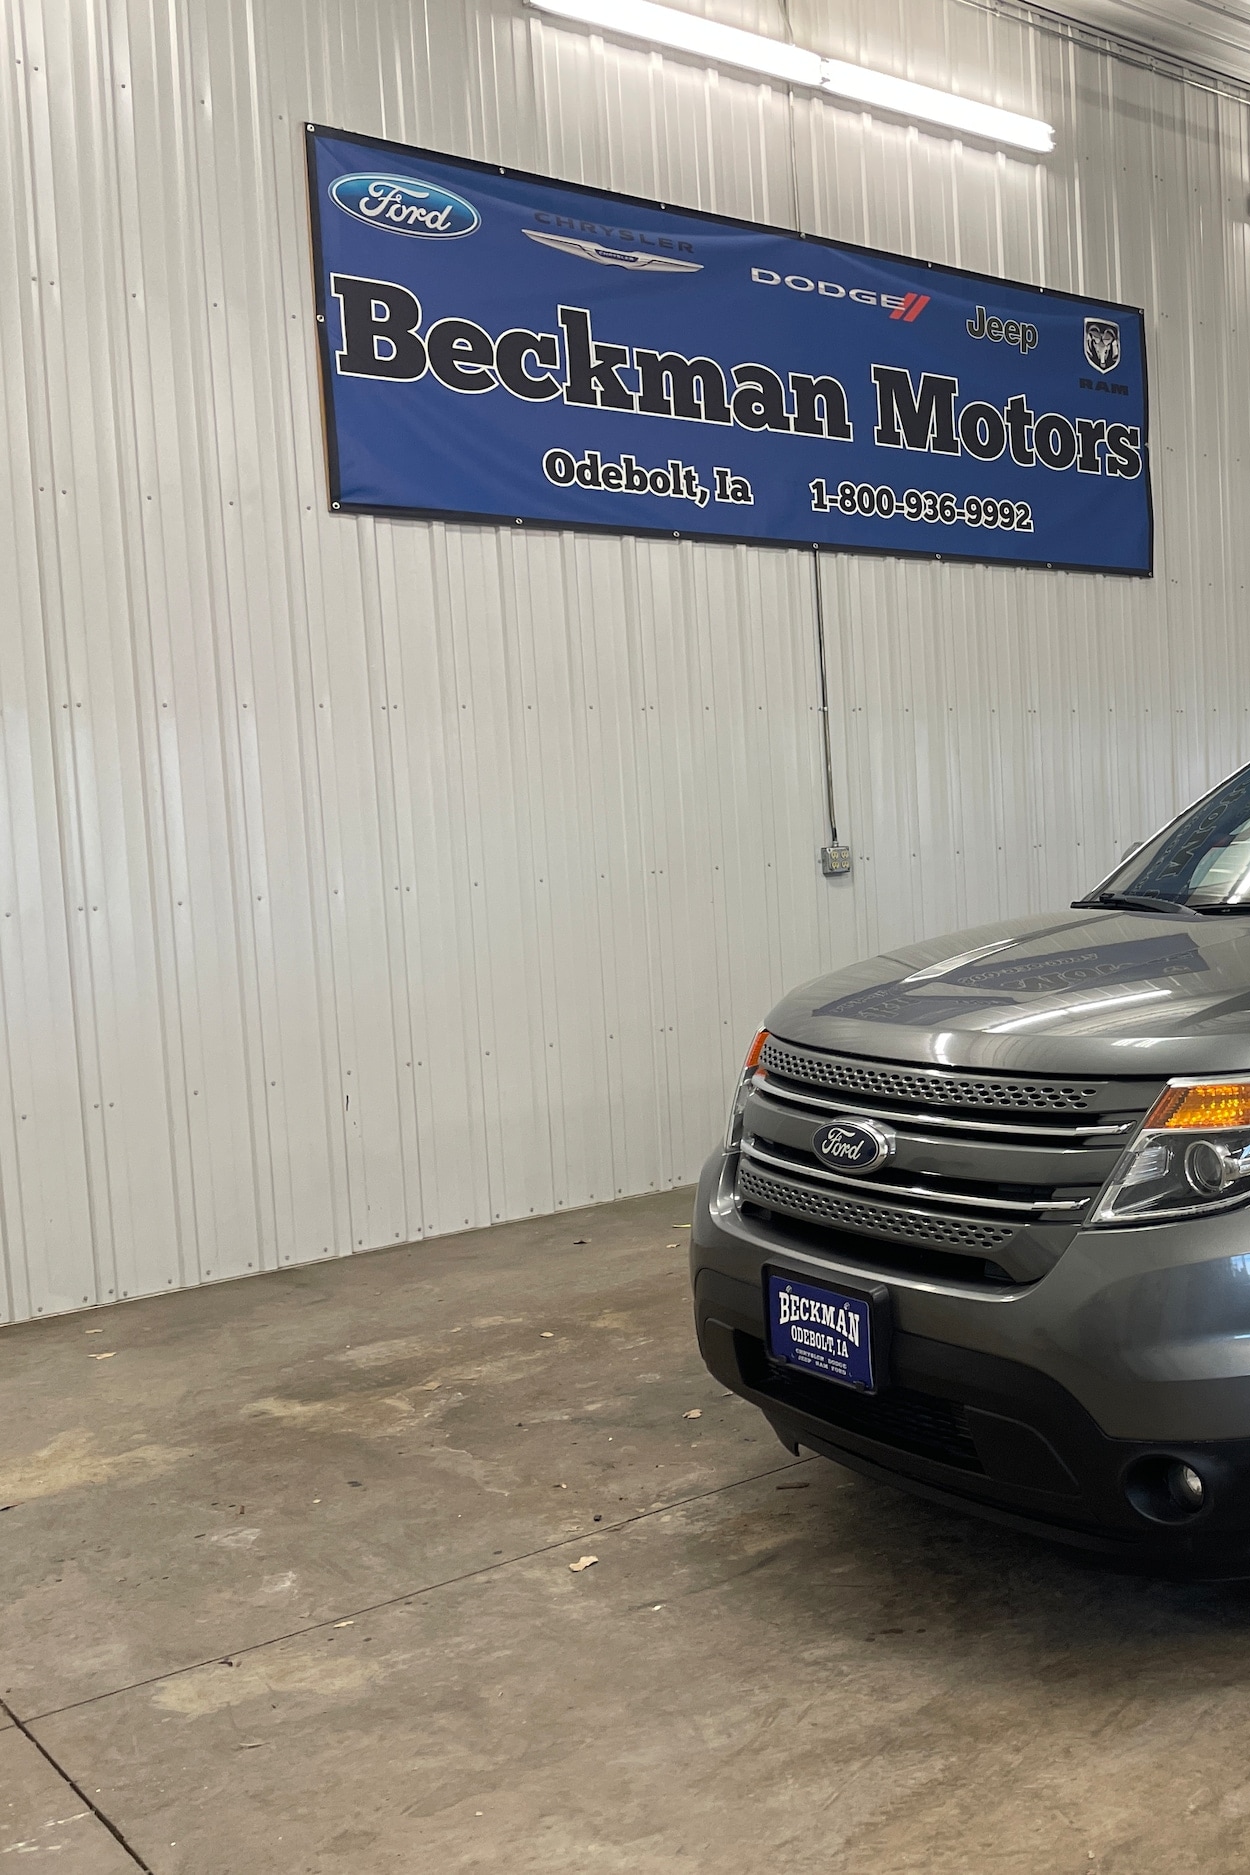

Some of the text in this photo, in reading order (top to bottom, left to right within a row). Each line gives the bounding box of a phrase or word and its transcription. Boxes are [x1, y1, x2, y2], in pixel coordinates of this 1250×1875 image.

[359, 180, 452, 232] Ford
[533, 210, 696, 255] CHRYSLER
[750, 267, 907, 311] DODGE
[966, 305, 1039, 354] Jeep
[330, 272, 1142, 480] Beckman Motors
[1079, 377, 1129, 396] RAM
[542, 447, 754, 508] Odebolt, Ia
[809, 478, 1034, 533] 1-800-936-9992
[821, 1127, 865, 1161] Ford
[779, 1291, 860, 1348] BECKMAN
[791, 1324, 849, 1358] ODEBOLT, IA
